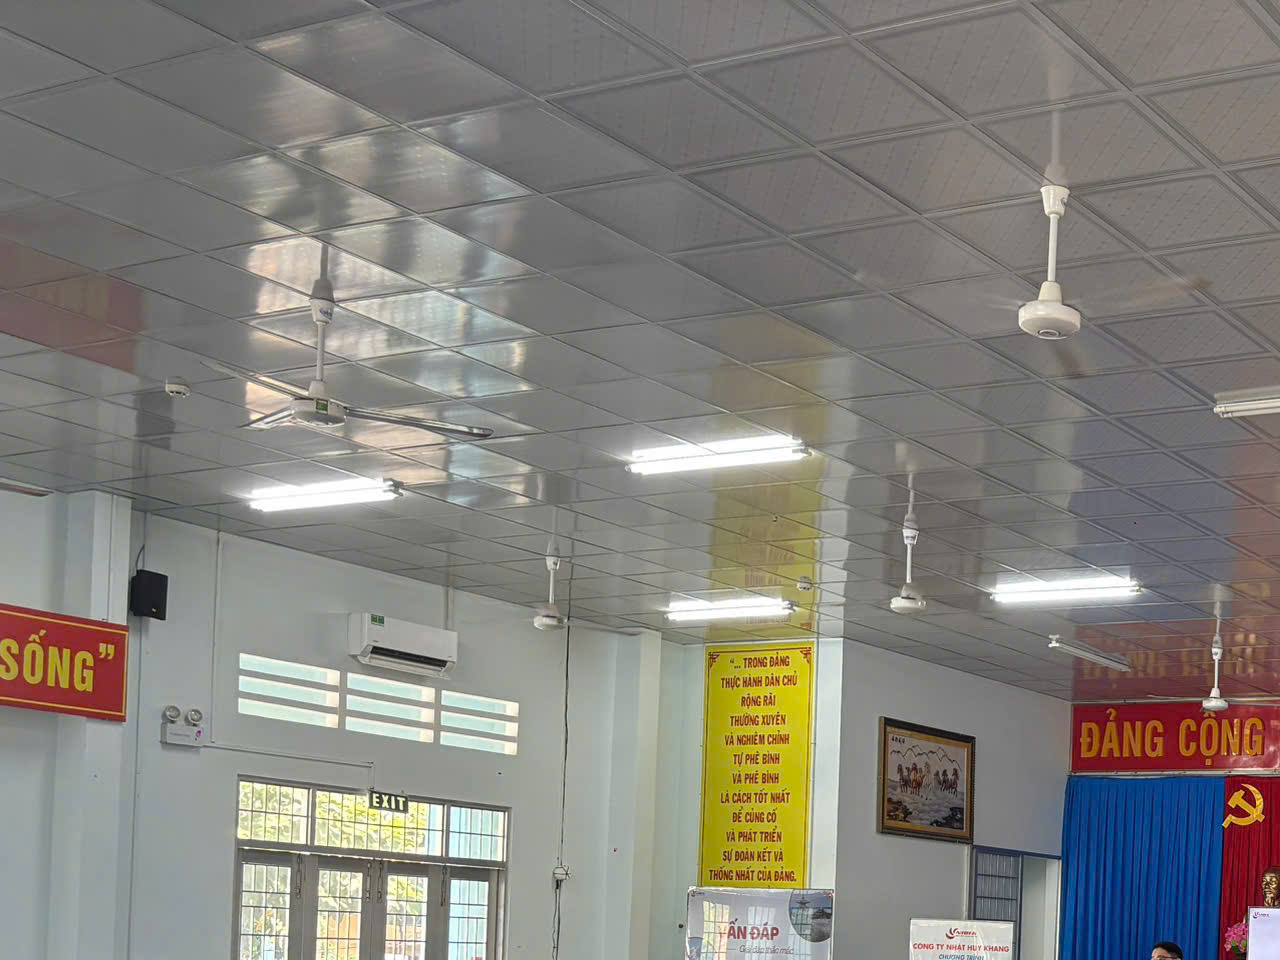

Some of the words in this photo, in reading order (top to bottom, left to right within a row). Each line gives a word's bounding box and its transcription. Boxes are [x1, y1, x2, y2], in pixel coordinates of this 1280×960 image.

[743, 657, 767, 668] TRONG
[769, 652, 790, 667] ĐẢNG
[721, 676, 740, 690] THỰC
[742, 674, 762, 688] HÀNH
[765, 673, 780, 687] DÂN
[782, 671, 798, 686] CHỦ
[741, 693, 761, 709] RỘNG
[763, 693, 776, 706] RÃI
[730, 712, 759, 726] THƯỜNG
[761, 712, 786, 726] XUYÊN
[725, 732, 734, 746] VÀ
[737, 732, 765, 745] NGHIÊM
[1080, 708, 1165, 758] ĐẢNG
[1179, 711, 1264, 766] CỘNG
[733, 752, 743, 767] TỰ
[745, 751, 759, 764] PHÊ
[762, 751, 780, 764] BÌNH
[732, 770, 742, 784] VÀ
[744, 770, 759, 784] PHÊ
[762, 770, 779, 784] BÌNH
[373, 793, 406, 810] EXIT
[720, 790, 729, 803] LÀ
[732, 790, 751, 803] CÁCH
[754, 788, 768, 803] TỐT
[770, 788, 790, 803] NHẤT
[732, 806, 743, 823] ĐỂ
[745, 808, 765, 823] CỦNG
[767, 808, 778, 823] CỐ
[726, 829, 735, 842] VÀ
[738, 829, 757, 842] PHÁT
[760, 825, 782, 842] TRIỂN
[723, 848, 733, 863] SỰ
[735, 848, 754, 861] ĐOÀN
[757, 847, 771, 861] KẾT
[774, 848, 783, 862] VÀ
[709, 866, 733, 880] THỐNG
[735, 866, 755, 880] NHẤT
[757, 866, 771, 881] CỦA
[719, 918, 747, 940] ẤN
[749, 922, 779, 940] ĐÁP
